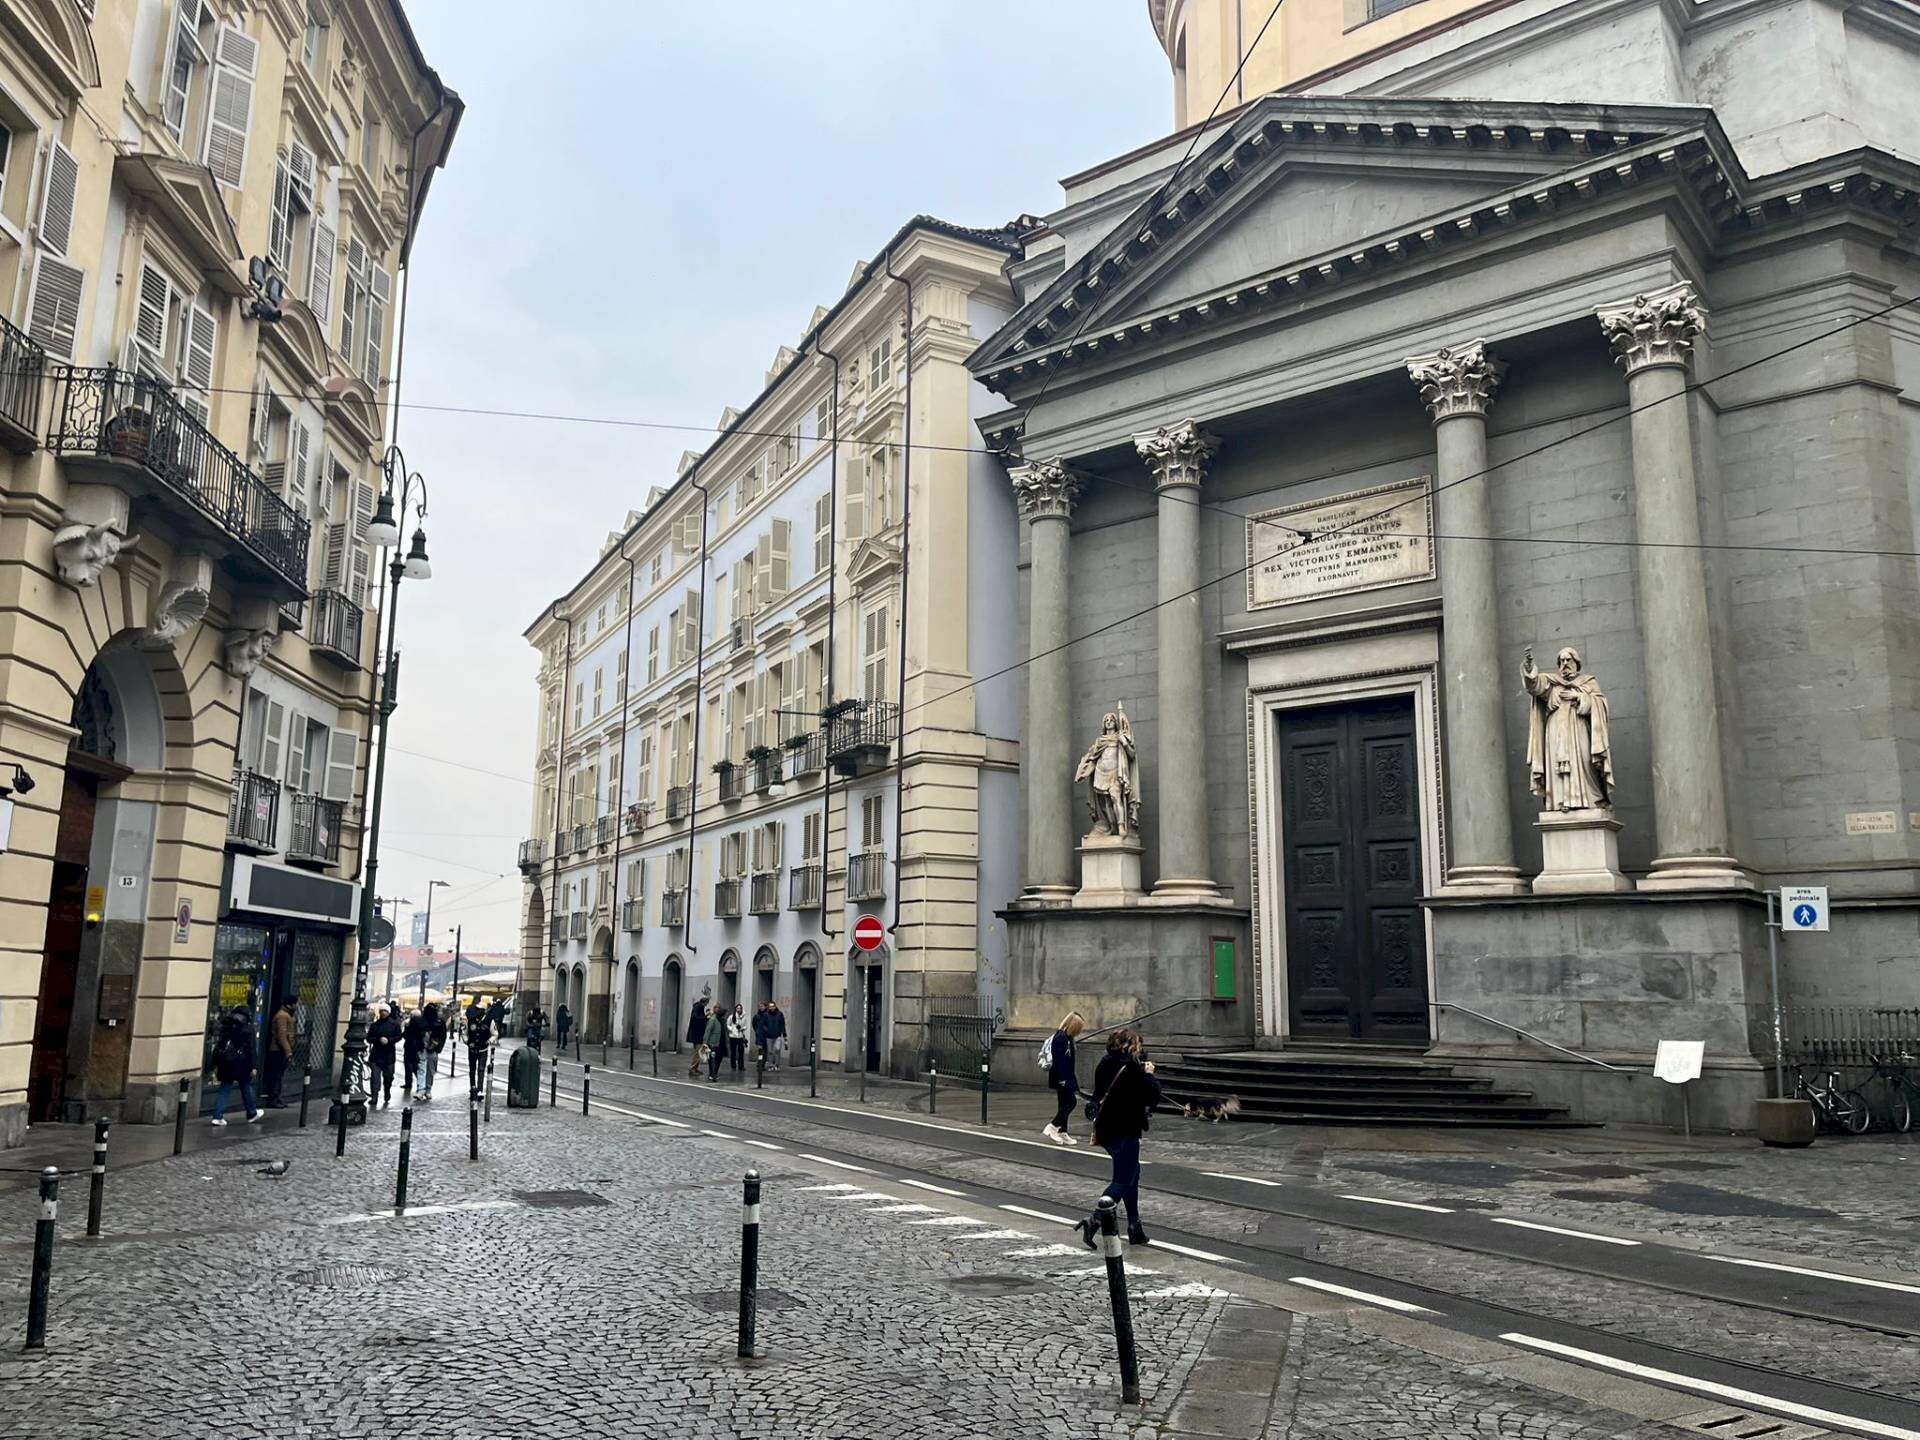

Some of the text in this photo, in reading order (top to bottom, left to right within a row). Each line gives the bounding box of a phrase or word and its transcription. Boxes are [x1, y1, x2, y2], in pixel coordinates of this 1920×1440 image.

[1317, 510, 1357, 523] BASILICAM
[1277, 540, 1296, 551] REX
[1351, 520, 1402, 537] ALBERTVS
[1292, 535, 1384, 558] FRONTE LAPIDEO AVXIT
[1264, 565, 1283, 574] REX
[1289, 553, 1340, 568] VICTORIVS
[1346, 541, 1403, 558] EMMANVEL
[1282, 553, 1398, 580] AVRO PICTVRIS MARMORIBVS
[1317, 570, 1359, 583] EXORNAVIT
